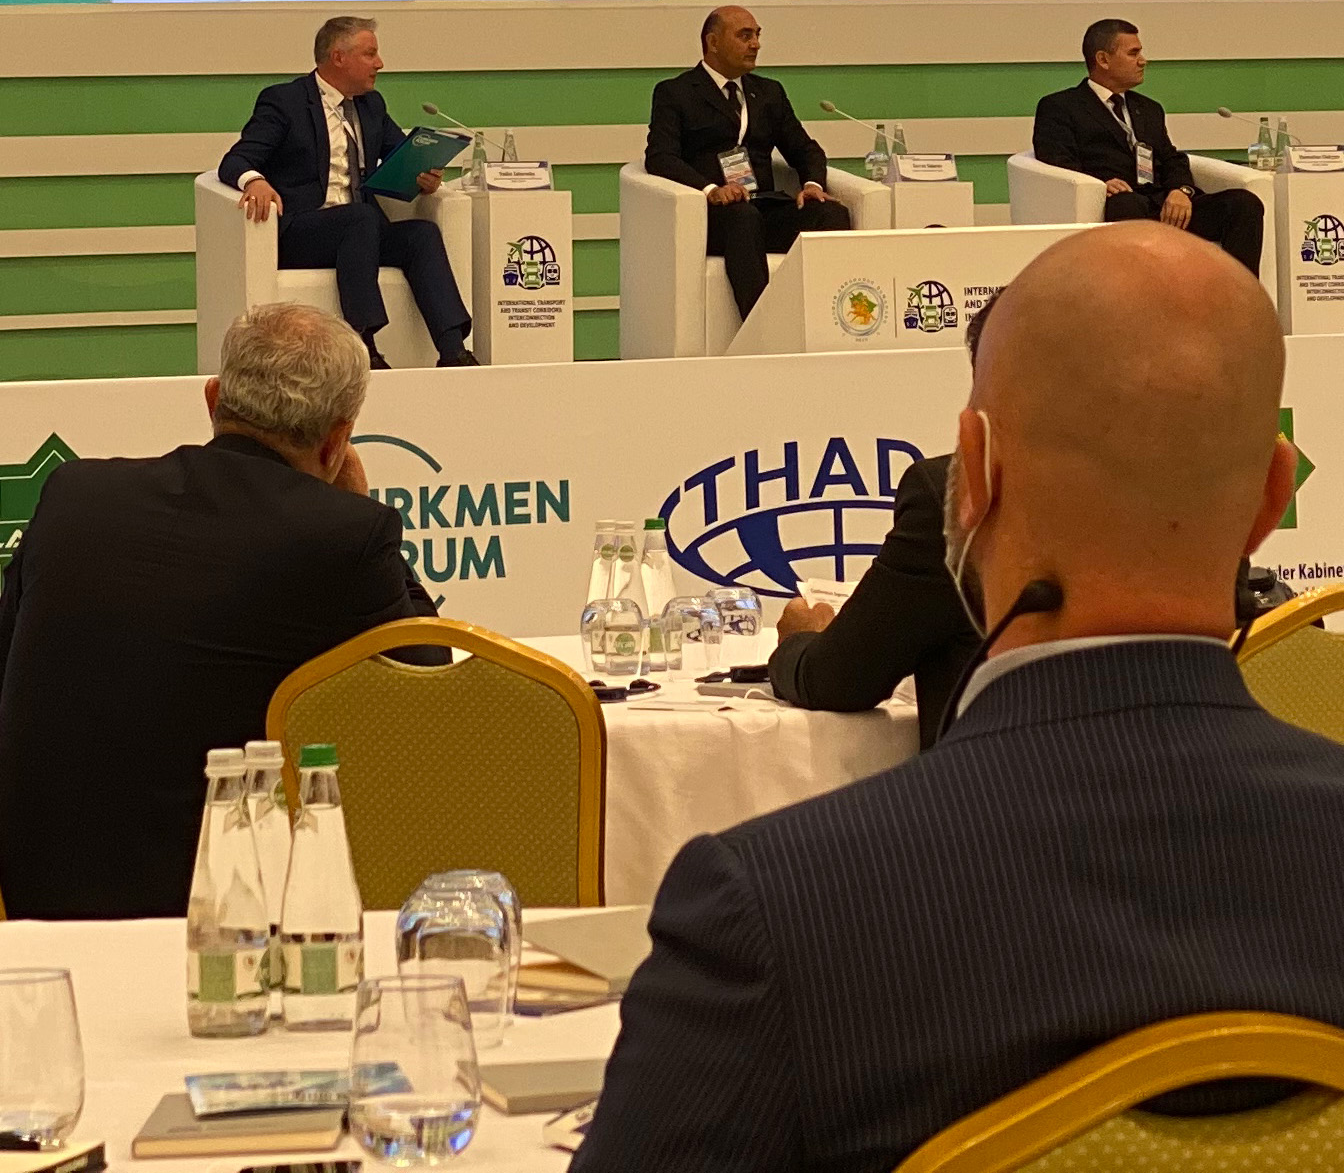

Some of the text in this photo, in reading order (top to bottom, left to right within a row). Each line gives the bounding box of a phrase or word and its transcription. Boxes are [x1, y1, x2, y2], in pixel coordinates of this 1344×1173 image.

[964, 299, 983, 309] AND
[370, 479, 570, 530] RKMEN
[684, 436, 924, 527] THAD
[402, 535, 506, 583] RUM
